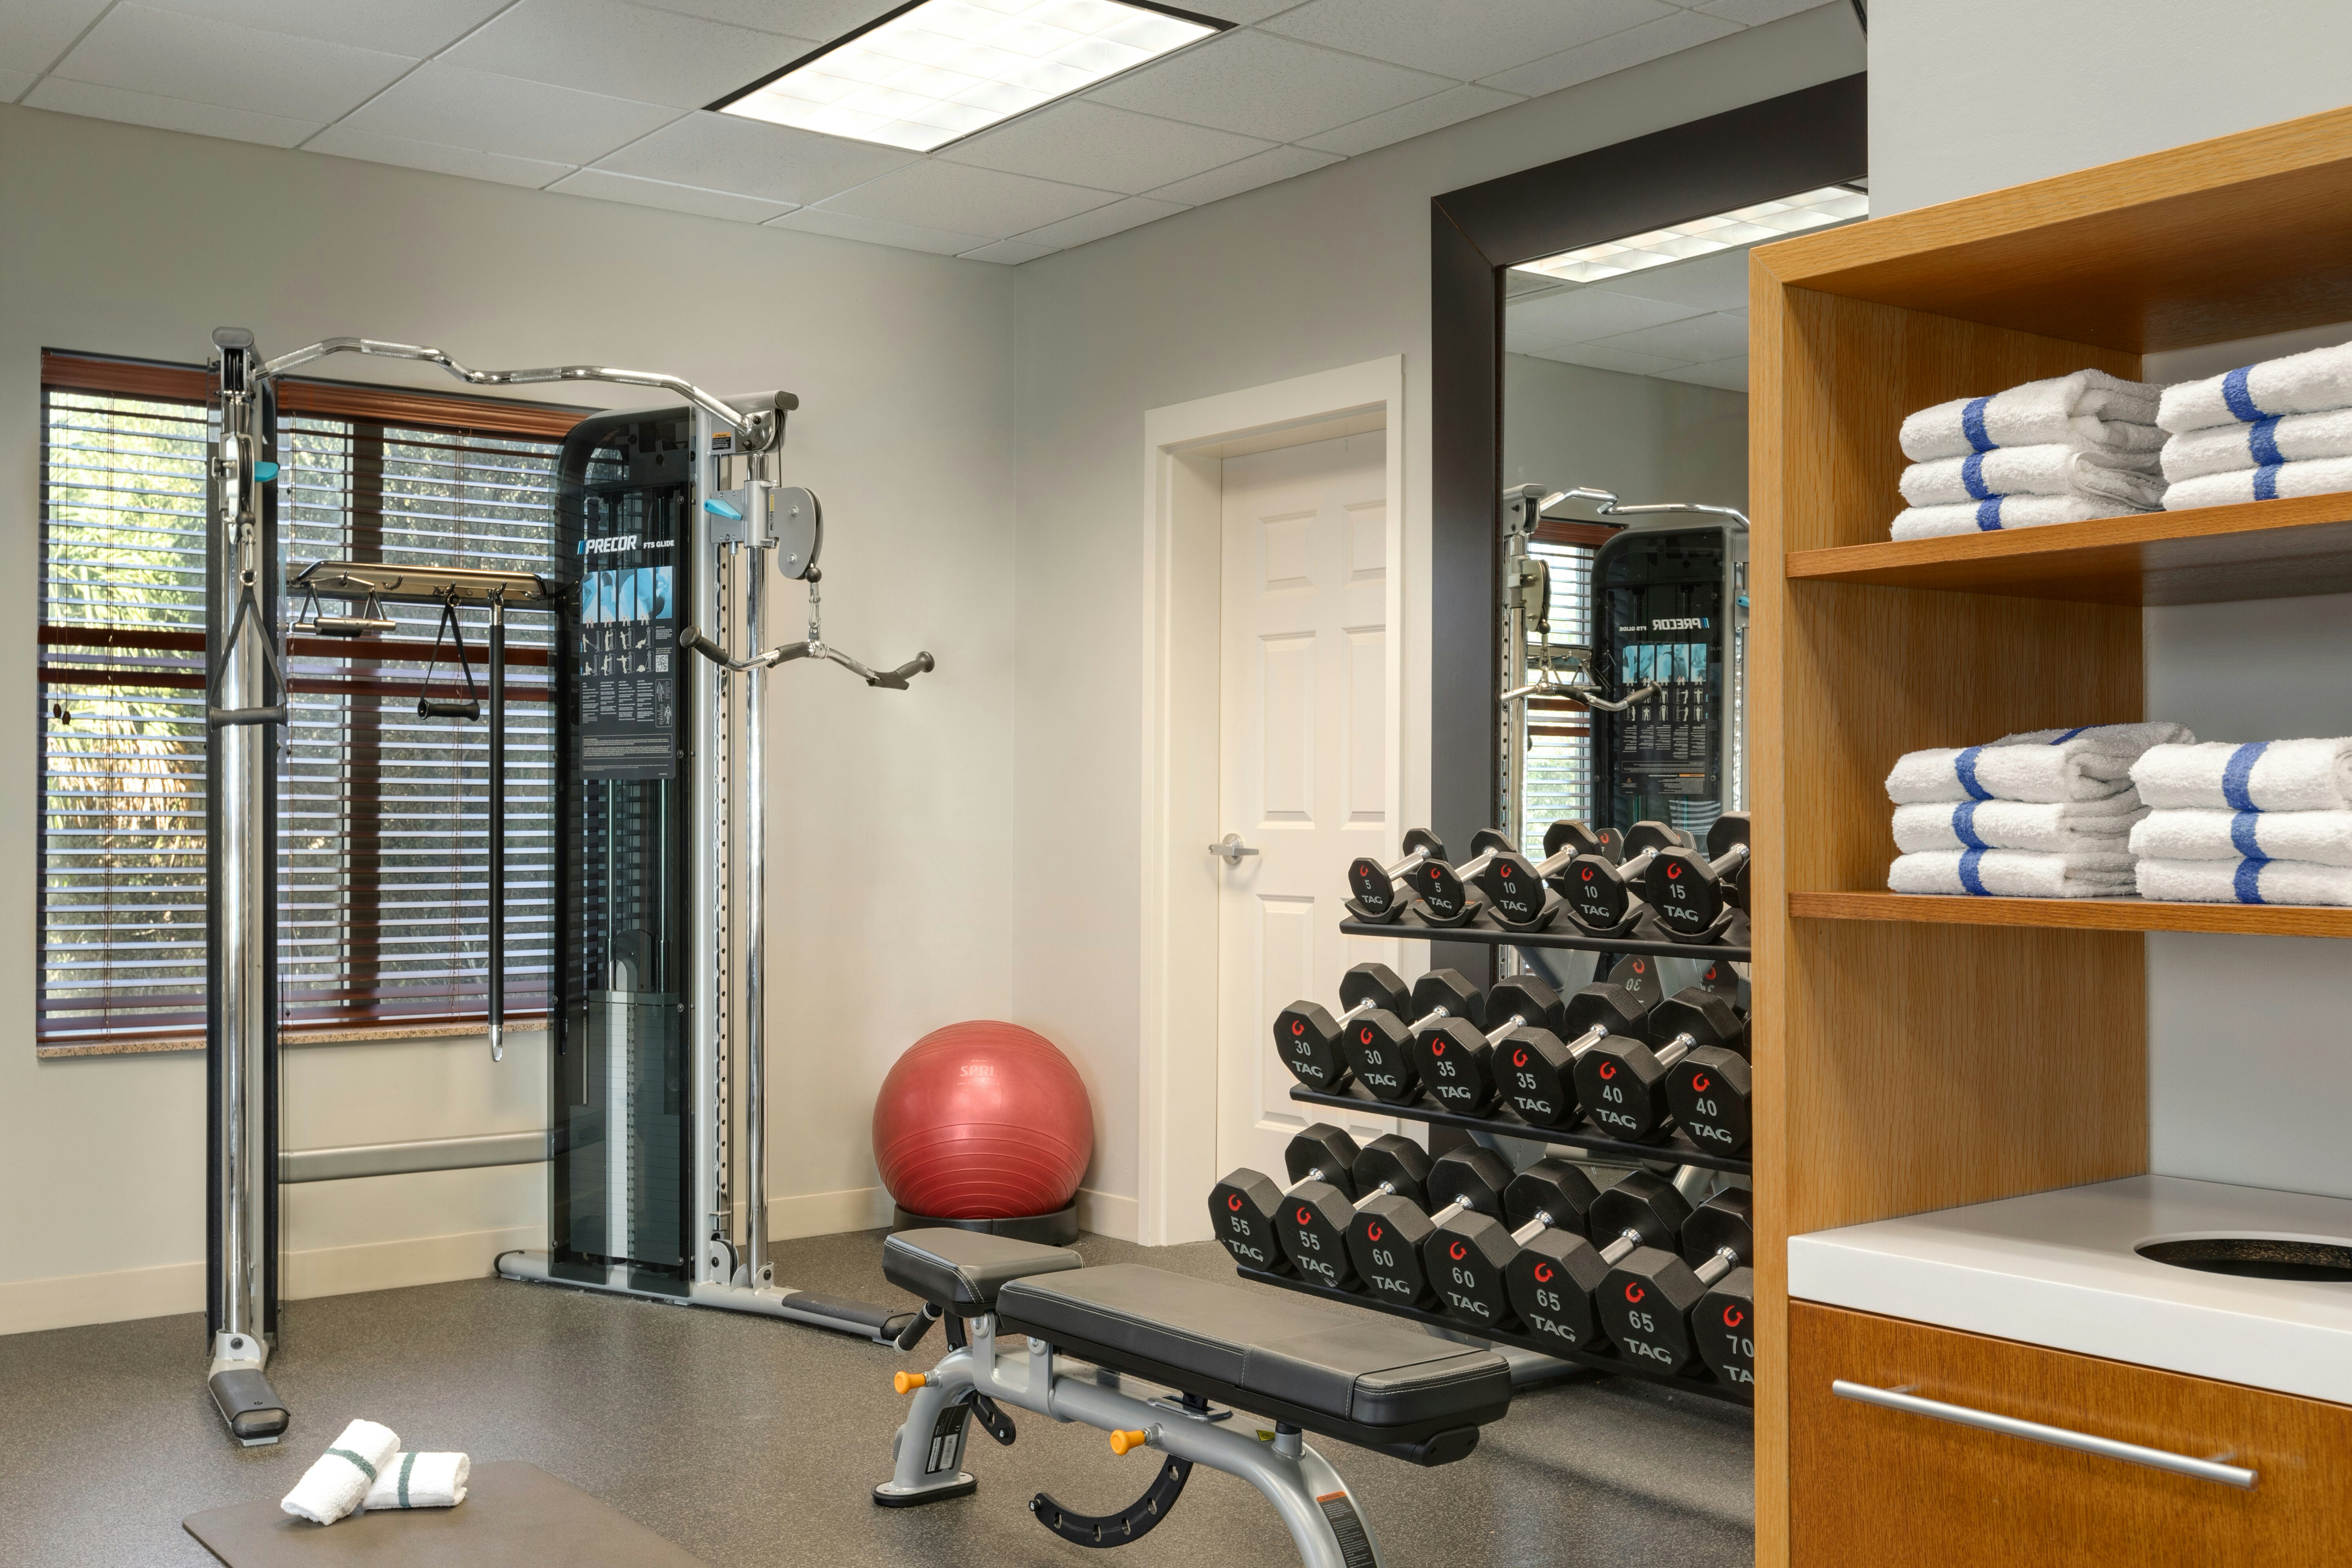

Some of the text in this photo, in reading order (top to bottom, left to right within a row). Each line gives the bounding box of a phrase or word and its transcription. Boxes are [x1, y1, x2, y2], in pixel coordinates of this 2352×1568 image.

[585, 535, 637, 554] PRECOR
[1365, 880, 1371, 889] 5
[1435, 882, 1441, 893] 5
[1503, 882, 1516, 894] 10
[1584, 885, 1598, 898] 10
[1670, 884, 1686, 899] 15
[1361, 895, 1383, 904] TAG
[1429, 897, 1452, 909] TAG
[1500, 900, 1527, 912] TAG
[1581, 904, 1609, 917] TAG
[1663, 905, 1699, 922] TAG
[1295, 1040, 1311, 1056] 30
[1365, 1050, 1382, 1065] 30
[960, 1065, 994, 1077] SPRI
[1292, 1061, 1323, 1078] TAG
[1437, 1061, 1455, 1076] 35
[1365, 1073, 1396, 1087] TAG
[1516, 1072, 1536, 1089] 35
[1437, 1086, 1471, 1099] TAG
[1602, 1085, 1622, 1103] 40
[1514, 1097, 1551, 1114] TAG
[1696, 1098, 1717, 1116] 40
[1596, 1108, 1637, 1129] TAG
[1690, 1122, 1732, 1143] TAG
[1230, 1216, 1250, 1236] 55
[1299, 1230, 1320, 1250] 55
[1229, 1240, 1263, 1262] TAG
[1373, 1249, 1394, 1267] 60
[1297, 1255, 1334, 1278] TAG
[1372, 1275, 1410, 1294] TAG
[1452, 1267, 1475, 1288] 60
[1447, 1291, 1490, 1318] TAG
[1537, 1289, 1561, 1311] 65
[1530, 1313, 1576, 1342] TAG
[1629, 1310, 1654, 1332] 65
[1623, 1337, 1672, 1365] TAG
[1726, 1334, 1754, 1357] 70
[1723, 1365, 1754, 1385] TA
